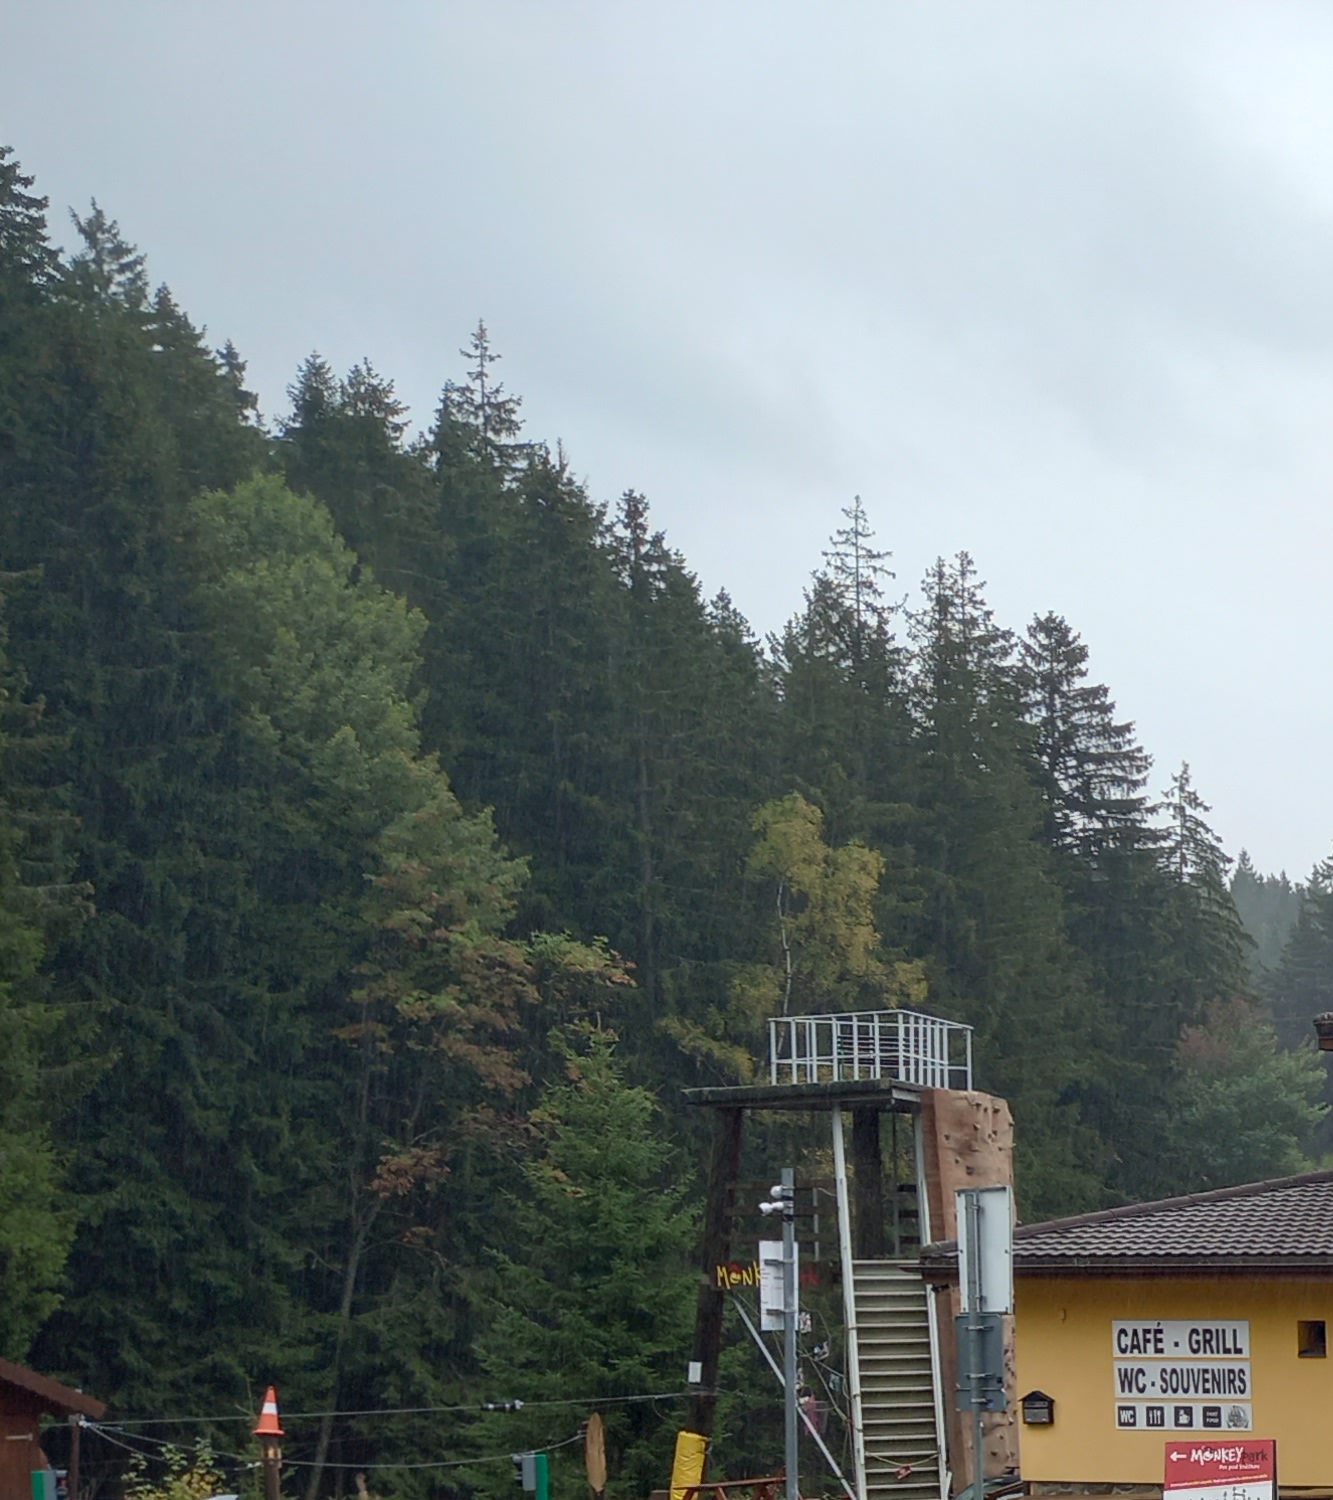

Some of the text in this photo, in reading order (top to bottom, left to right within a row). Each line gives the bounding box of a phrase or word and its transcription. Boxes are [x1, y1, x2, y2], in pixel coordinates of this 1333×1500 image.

[1116, 1321, 1165, 1355] CAFÉ
[1188, 1327, 1244, 1355] GRILL
[1117, 1367, 1147, 1394] WC
[1159, 1367, 1247, 1395] SOUVENIRS
[1120, 1409, 1135, 1424] WC
[1190, 1446, 1243, 1466] MONKEY
